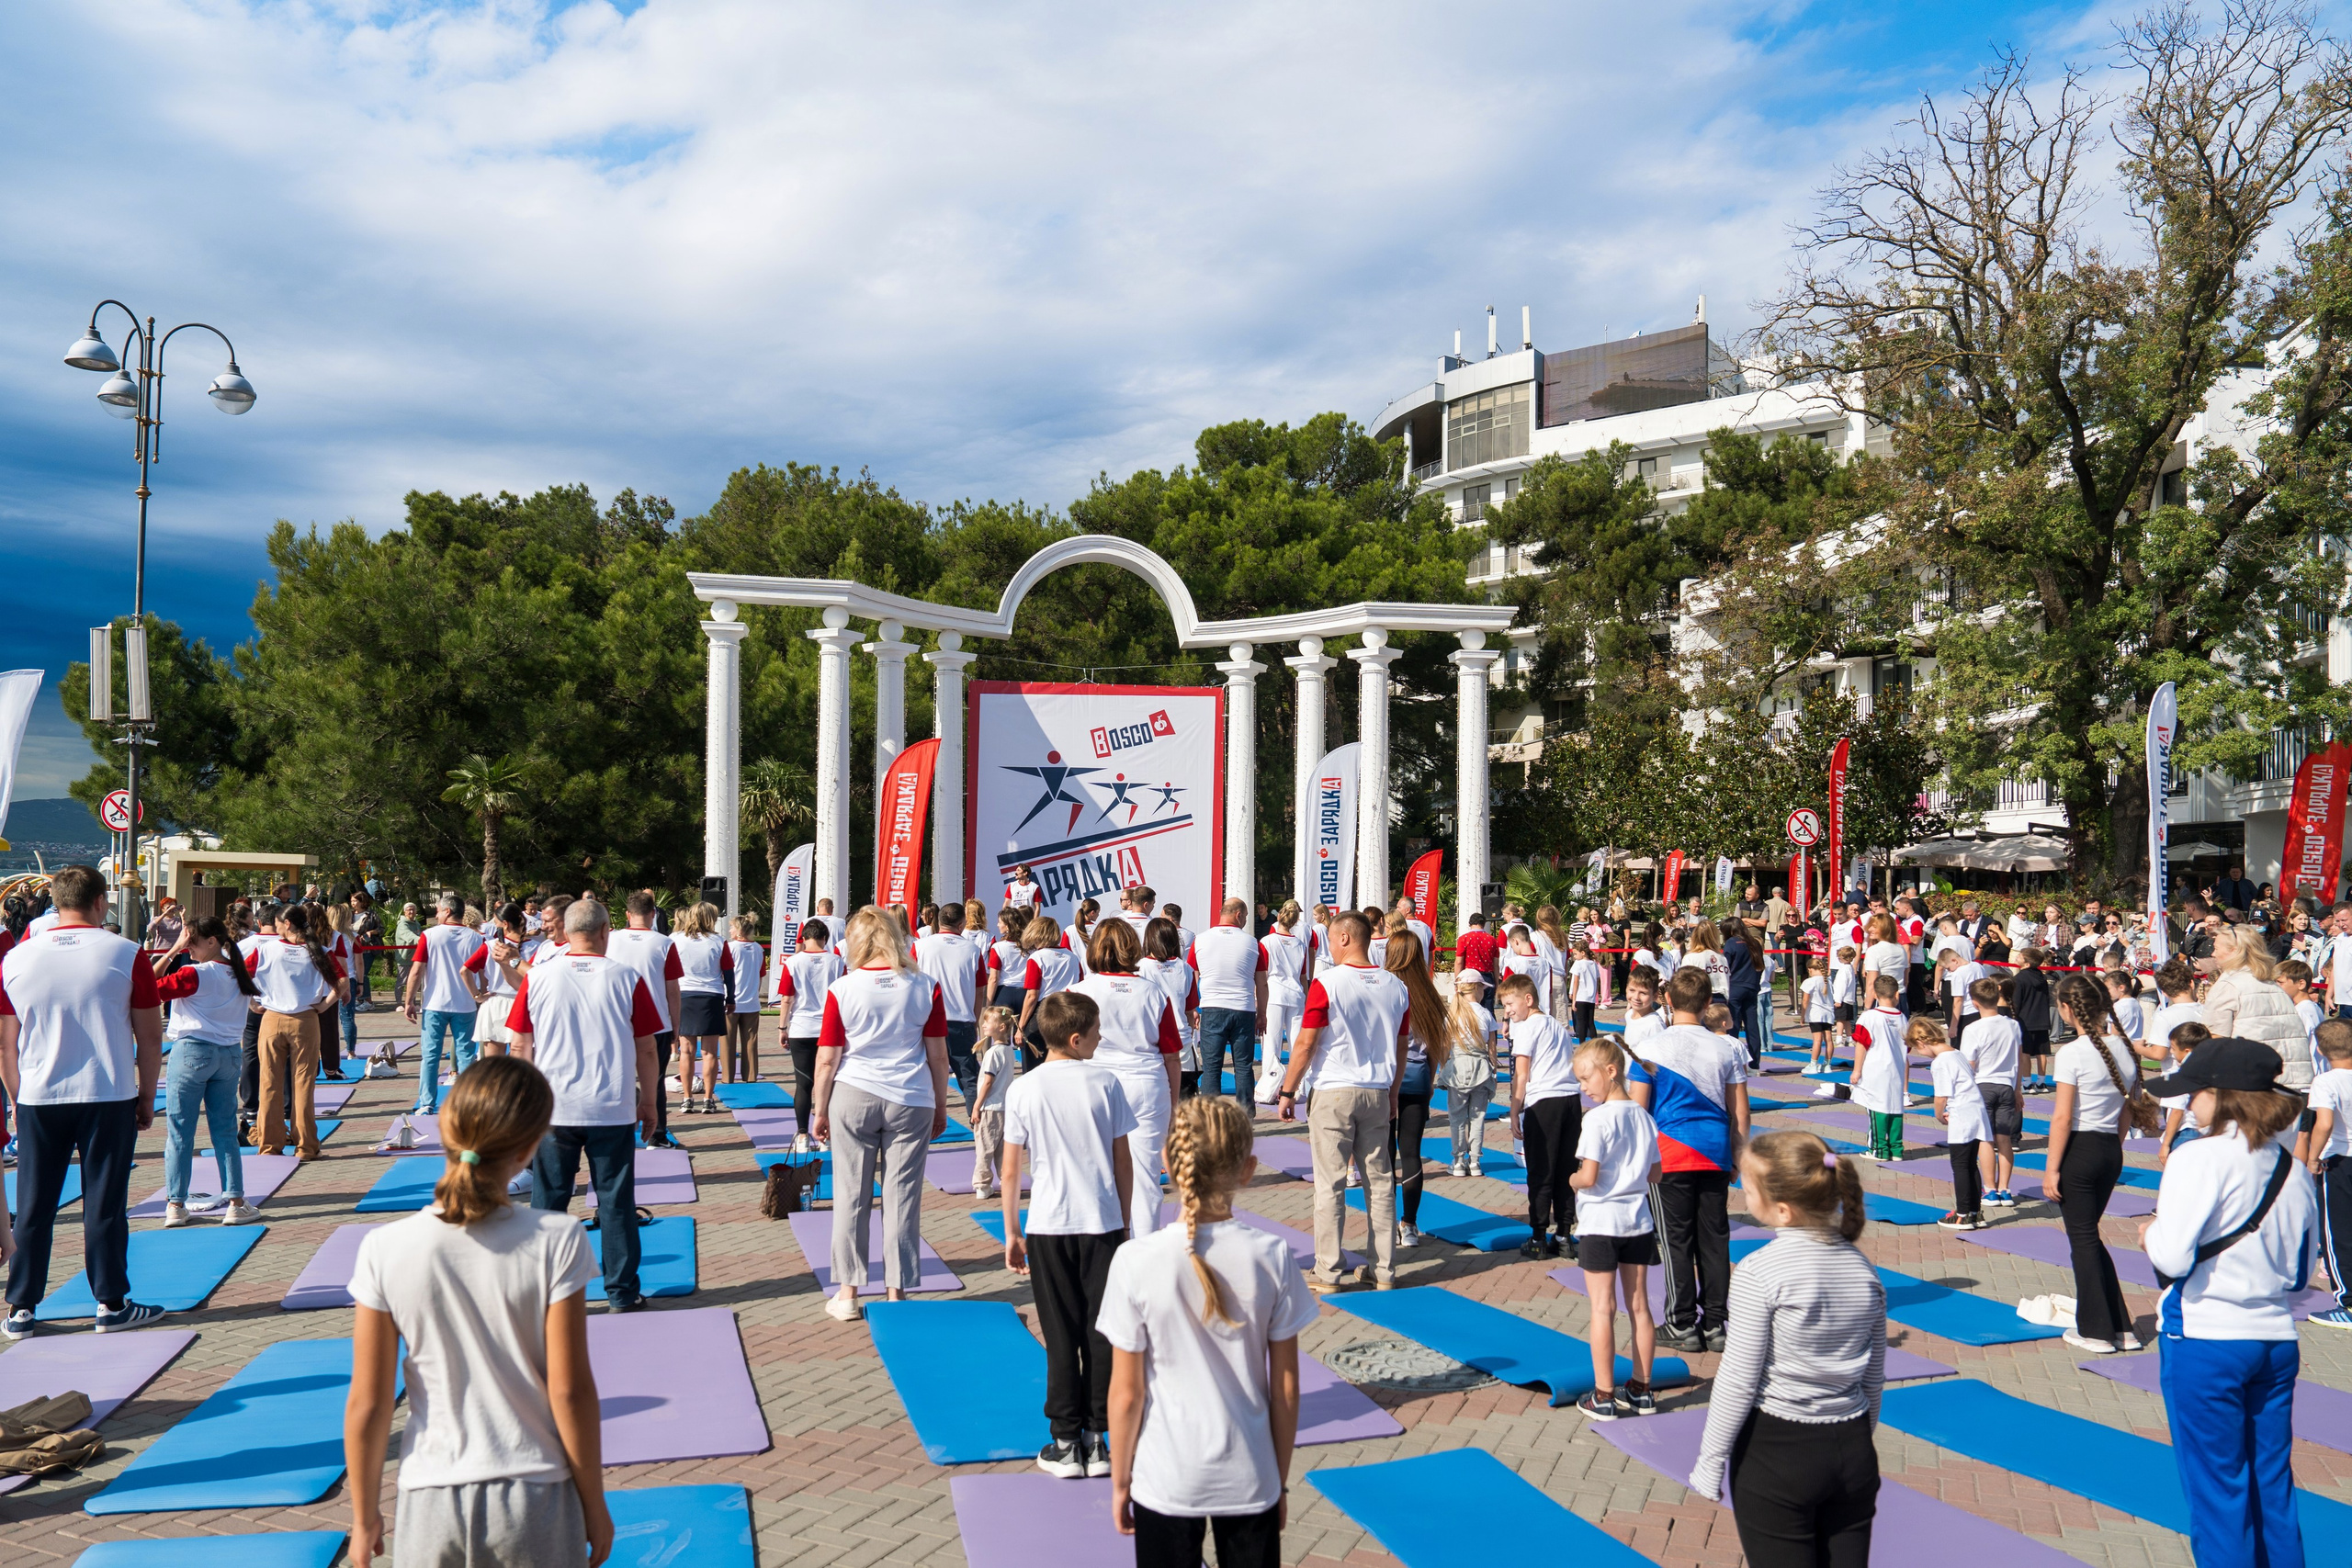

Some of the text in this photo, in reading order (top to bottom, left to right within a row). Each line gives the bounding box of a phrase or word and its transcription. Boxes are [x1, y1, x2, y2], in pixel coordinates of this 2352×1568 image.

[1090, 726, 1153, 758] BOSCO
[1320, 777, 1341, 846] ЗАРЯДКА
[2307, 763, 2334, 824] ЗАРЯДКА
[886, 773, 919, 911] OSCO ЗАРЯДКА
[786, 866, 801, 914] ЗАРЯДКА
[1003, 845, 1147, 908] АРЯДКА
[1414, 870, 1430, 916] ЗАРЯДКА
[1703, 964, 1729, 975] OSCO
